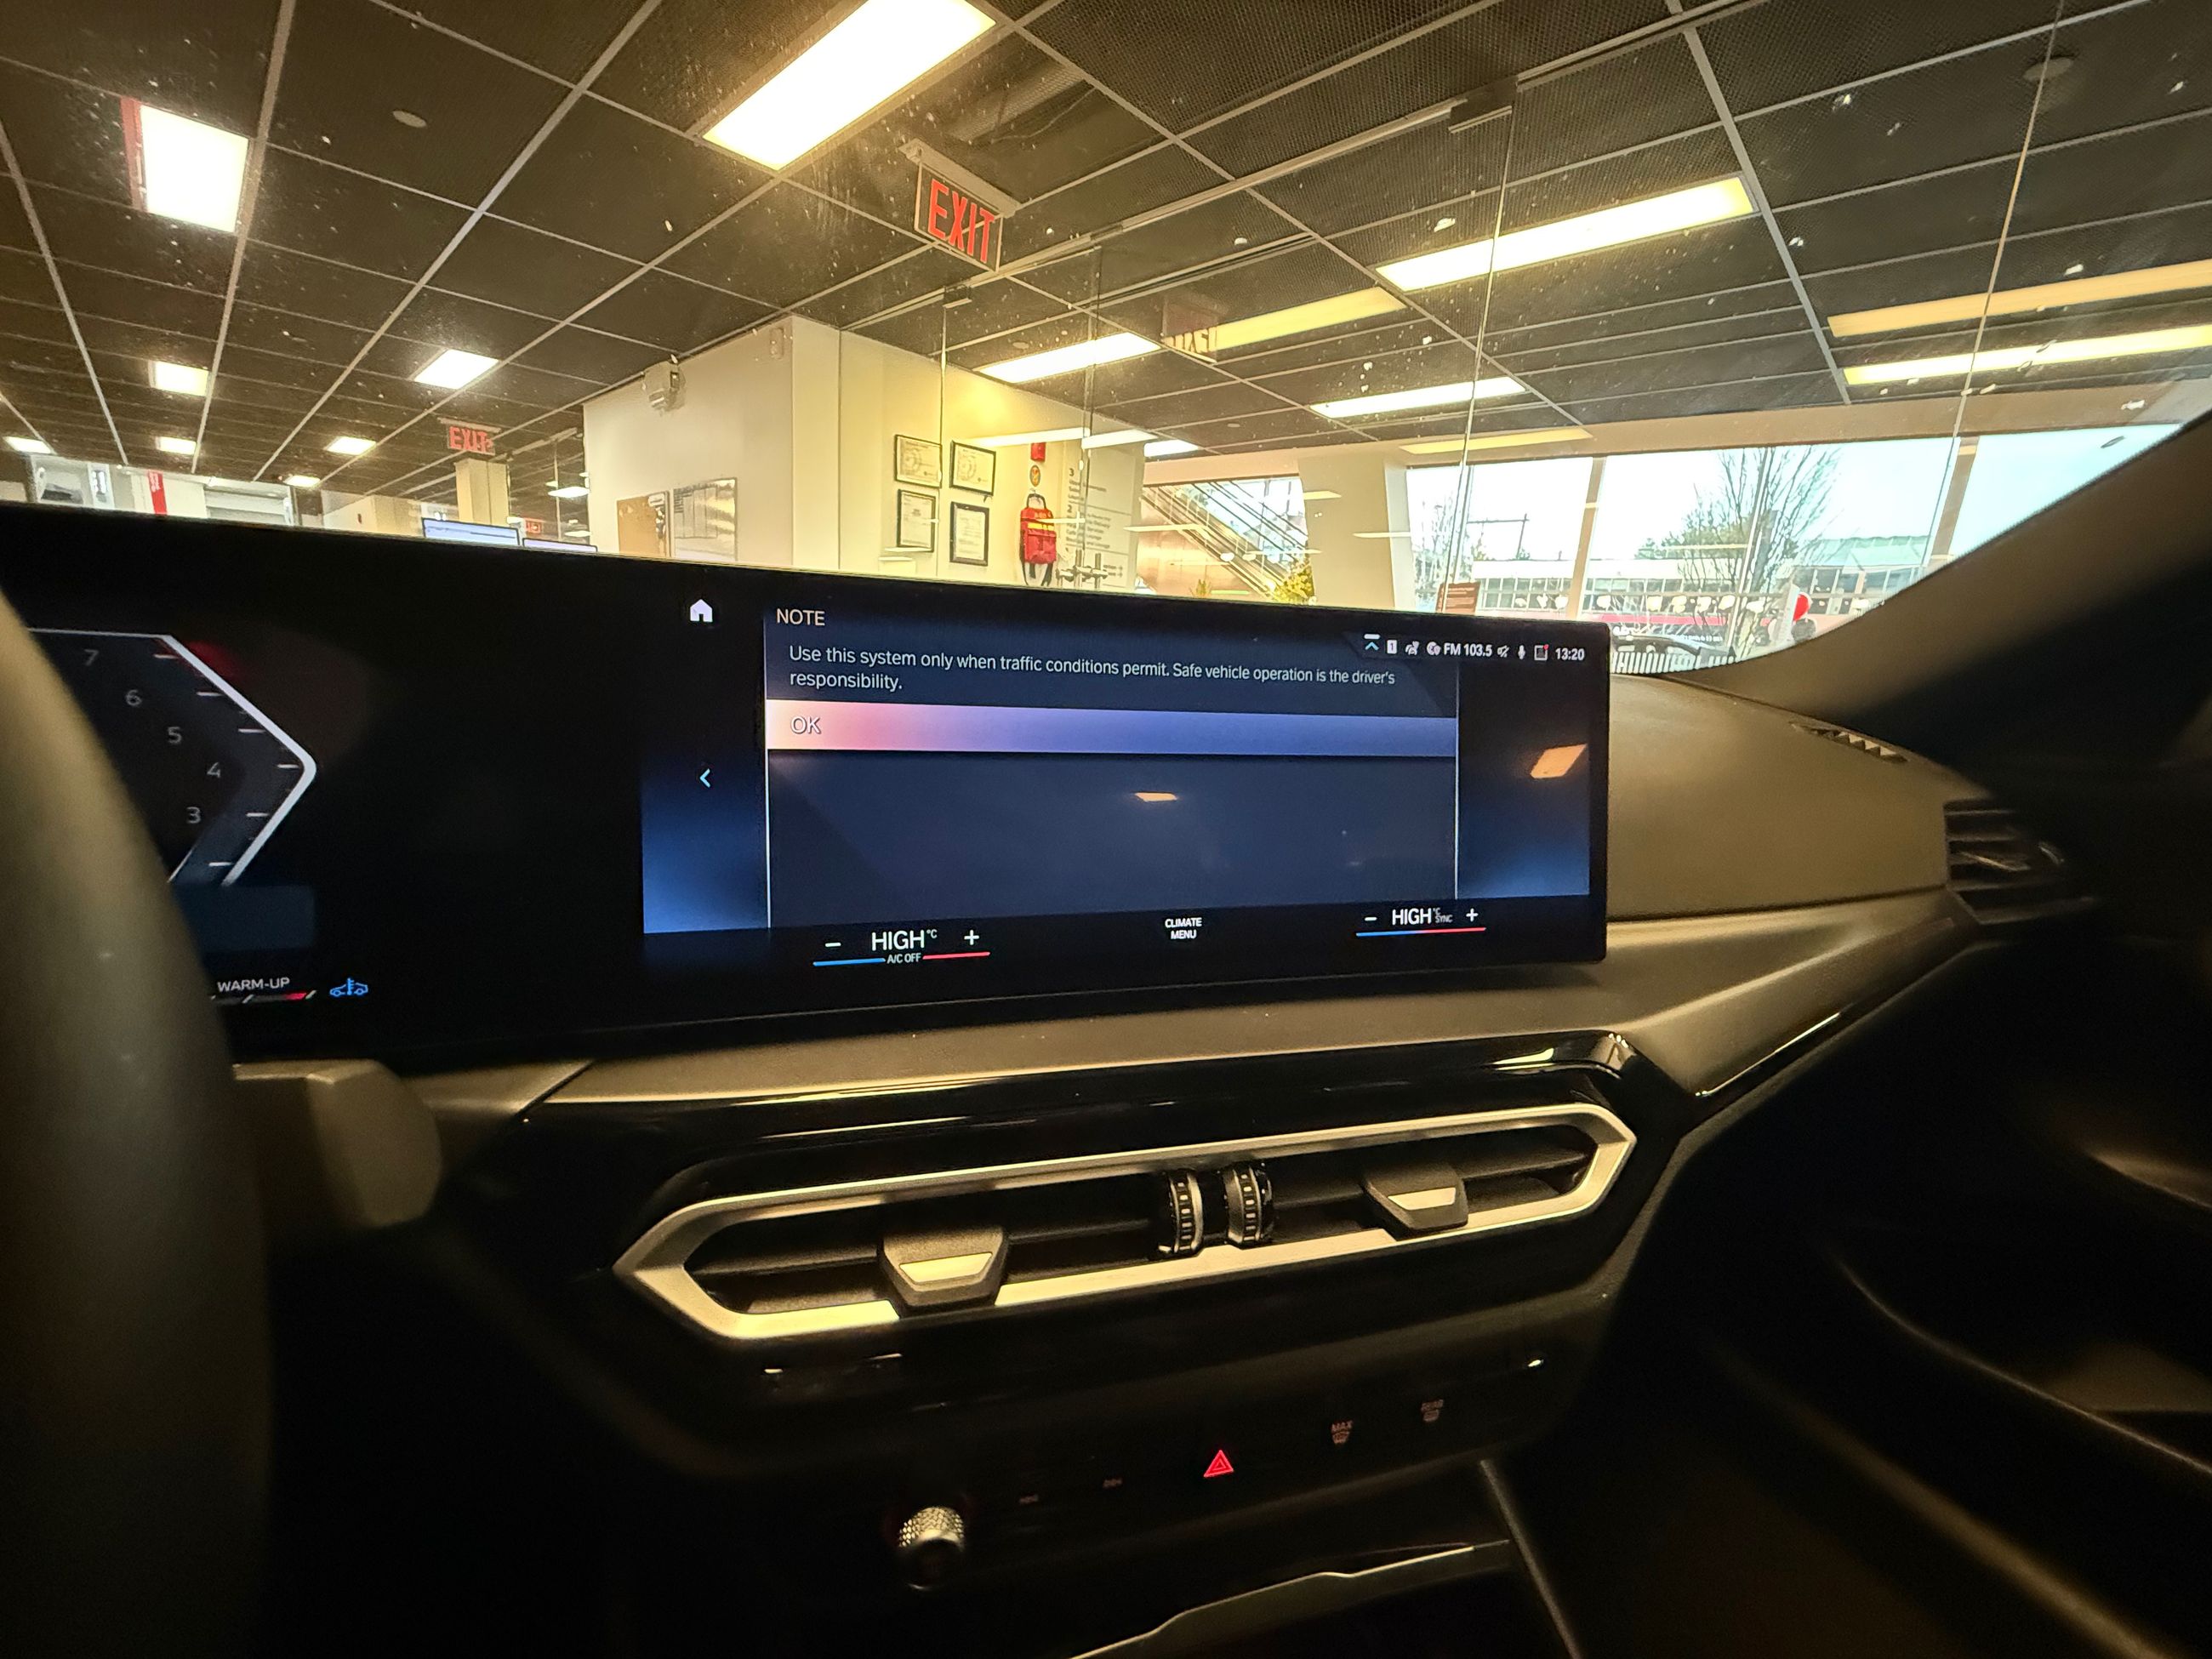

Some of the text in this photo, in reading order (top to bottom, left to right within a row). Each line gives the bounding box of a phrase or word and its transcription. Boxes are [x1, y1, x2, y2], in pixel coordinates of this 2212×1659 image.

[928, 178, 995, 264] EXIT
[449, 425, 489, 453] EXIT
[776, 607, 825, 626] NOTE
[84, 649, 99, 666] 7
[1444, 642, 1492, 657] FM 103.5
[1555, 647, 1585, 661] 13:20
[790, 645, 1395, 685] Use this system only when traffic conditions permit. Safe vehicle operation is the driver's
[790, 670, 903, 693] responsibility.
[126, 689, 142, 707] 6
[790, 716, 822, 735] OK
[168, 727, 182, 744] 5
[207, 762, 221, 778] 4
[187, 806, 201, 824] 3
[1165, 917, 1202, 928] CLIMATE
[1392, 908, 1432, 926] HIGH
[1434, 914, 1453, 923] SYNC
[871, 929, 925, 951] HIGH
[1171, 929, 1197, 939] MENU
[887, 952, 921, 964] A/C OFF
[217, 977, 290, 993] WARM-UP
